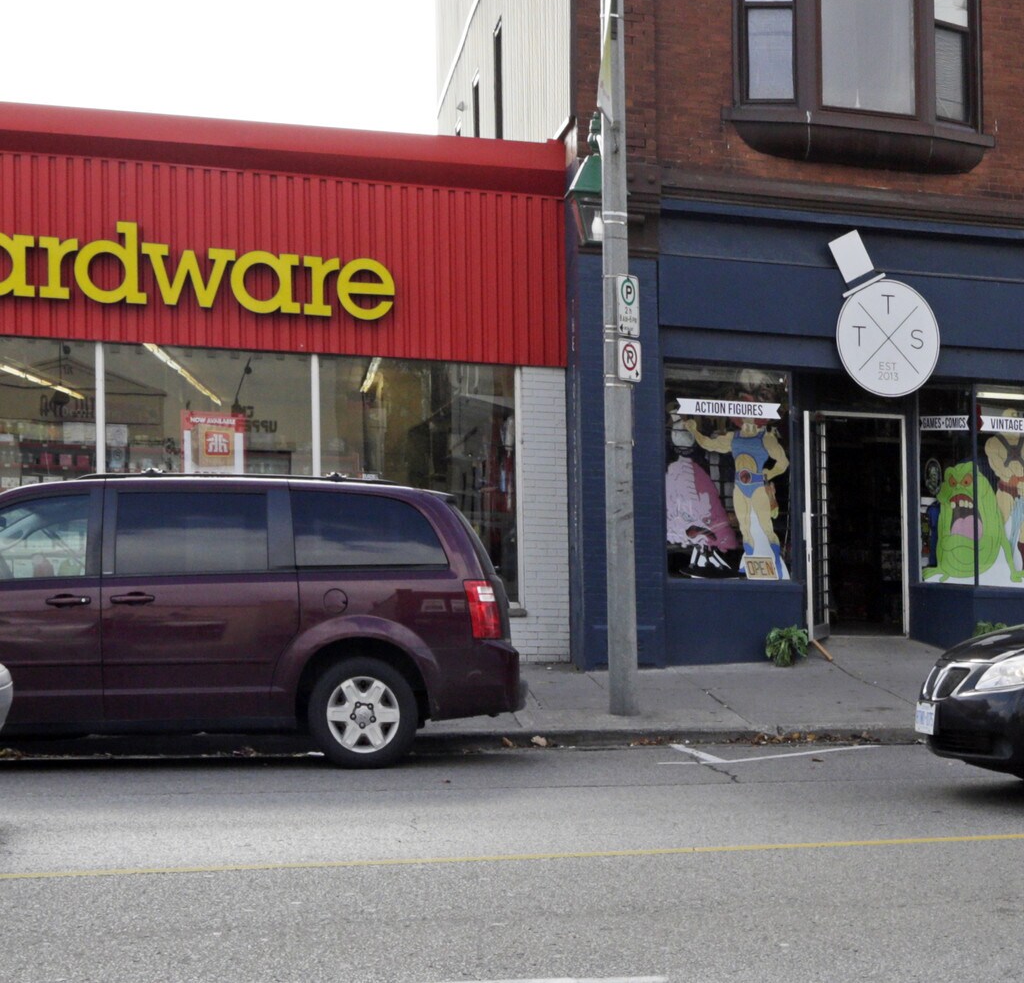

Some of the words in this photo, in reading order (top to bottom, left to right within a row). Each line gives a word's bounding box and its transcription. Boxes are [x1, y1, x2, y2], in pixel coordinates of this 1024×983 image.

[879, 361, 897, 371] EST
[878, 371, 899, 382] 2013
[695, 401, 726, 414] ACTION
[728, 403, 763, 416] FIGURES
[990, 418, 1023, 431] VINTAGE
[746, 560, 775, 576] OPEN
